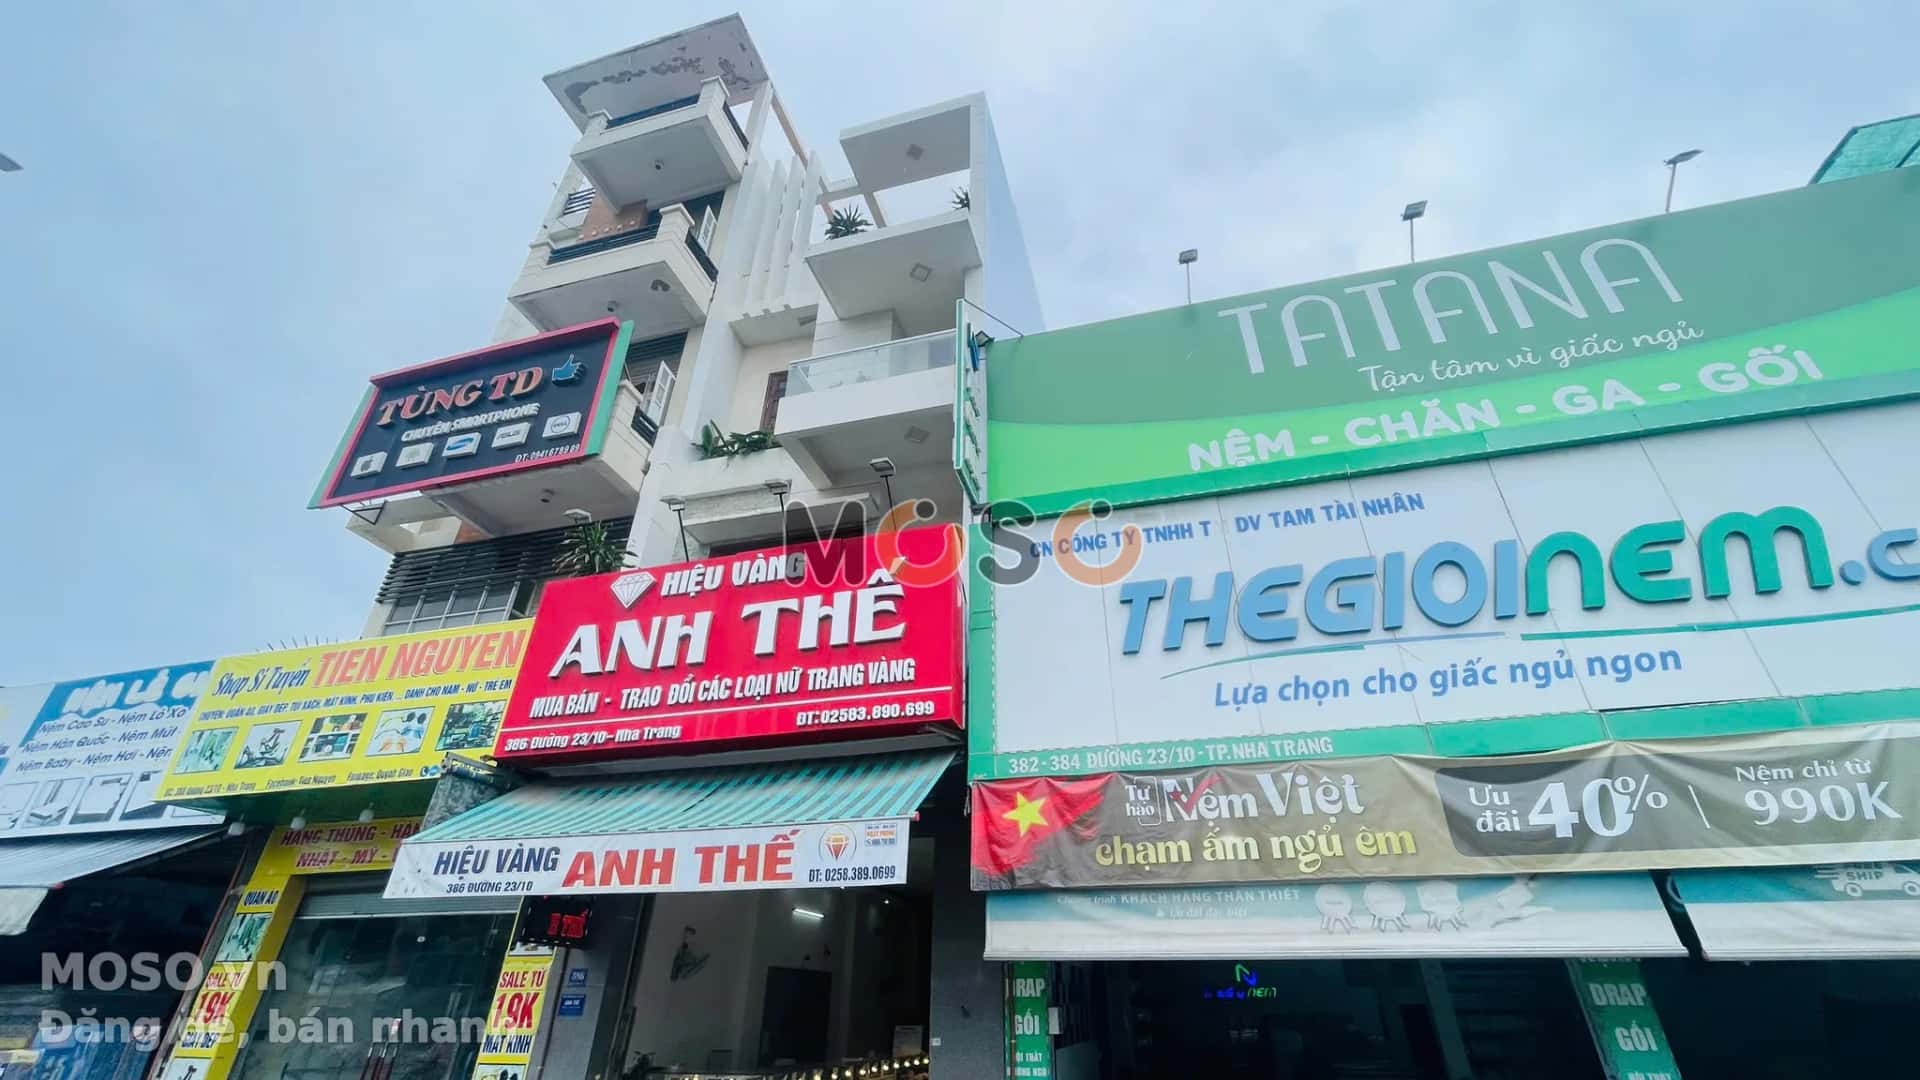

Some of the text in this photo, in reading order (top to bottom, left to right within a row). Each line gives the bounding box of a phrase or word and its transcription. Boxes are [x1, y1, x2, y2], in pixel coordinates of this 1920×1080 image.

[1217, 237, 1685, 375] TATANA
[1357, 364, 1425, 396] Tận
[1431, 346, 1500, 382] tâm
[1550, 329, 1623, 369] giấc
[1631, 320, 1705, 360] ngủ
[489, 366, 544, 401] TD
[1187, 428, 1296, 471] NỆM
[1344, 397, 1501, 447] CHĂN
[1554, 377, 1647, 417] GA
[1699, 345, 1824, 394] GỐI
[1058, 530, 1107, 556] CÔNG
[1111, 530, 1136, 549] TY
[1143, 522, 1194, 545] TNHH
[1235, 514, 1261, 534] DV
[1362, 491, 1424, 518] NHÂN
[660, 562, 724, 599] HIỆU
[385, 629, 527, 681] NGUYEN
[549, 610, 713, 679] ANH
[529, 696, 564, 719] MUA
[565, 688, 600, 715] BÁN
[620, 684, 663, 710] TRAO
[698, 674, 732, 701] CÁC
[733, 674, 771, 702] LOẠI
[807, 663, 865, 691] TRANG
[867, 656, 916, 685] VÀNG
[1214, 646, 1684, 709] Lựa chọn cho giấc ngủ ngon
[644, 724, 683, 743] Trang
[1086, 745, 1143, 770] ĐƯỜNG
[1147, 745, 1195, 766] 23/10
[1274, 736, 1334, 757] TRANG
[1735, 763, 1794, 784] Nệm
[1256, 771, 1365, 824] Việt
[1527, 774, 1670, 839] 40%
[1744, 781, 1904, 827] 990K
[1475, 807, 1521, 834] đãi
[433, 845, 490, 880] HIỆU
[495, 842, 561, 874] VÀNG
[561, 829, 802, 889] ANH THẾ
[1095, 835, 1192, 871] chạm
[1270, 825, 1344, 873] ngủ
[1355, 825, 1417, 856] êm
[446, 883, 466, 894] 386
[503, 880, 534, 892] 23/10
[825, 865, 896, 882] 0258.389.0699
[1846, 871, 1884, 881] SHIP
[499, 970, 527, 989] SALE
[1588, 983, 1647, 1006] DRAP
[491, 991, 540, 1030] 19K
